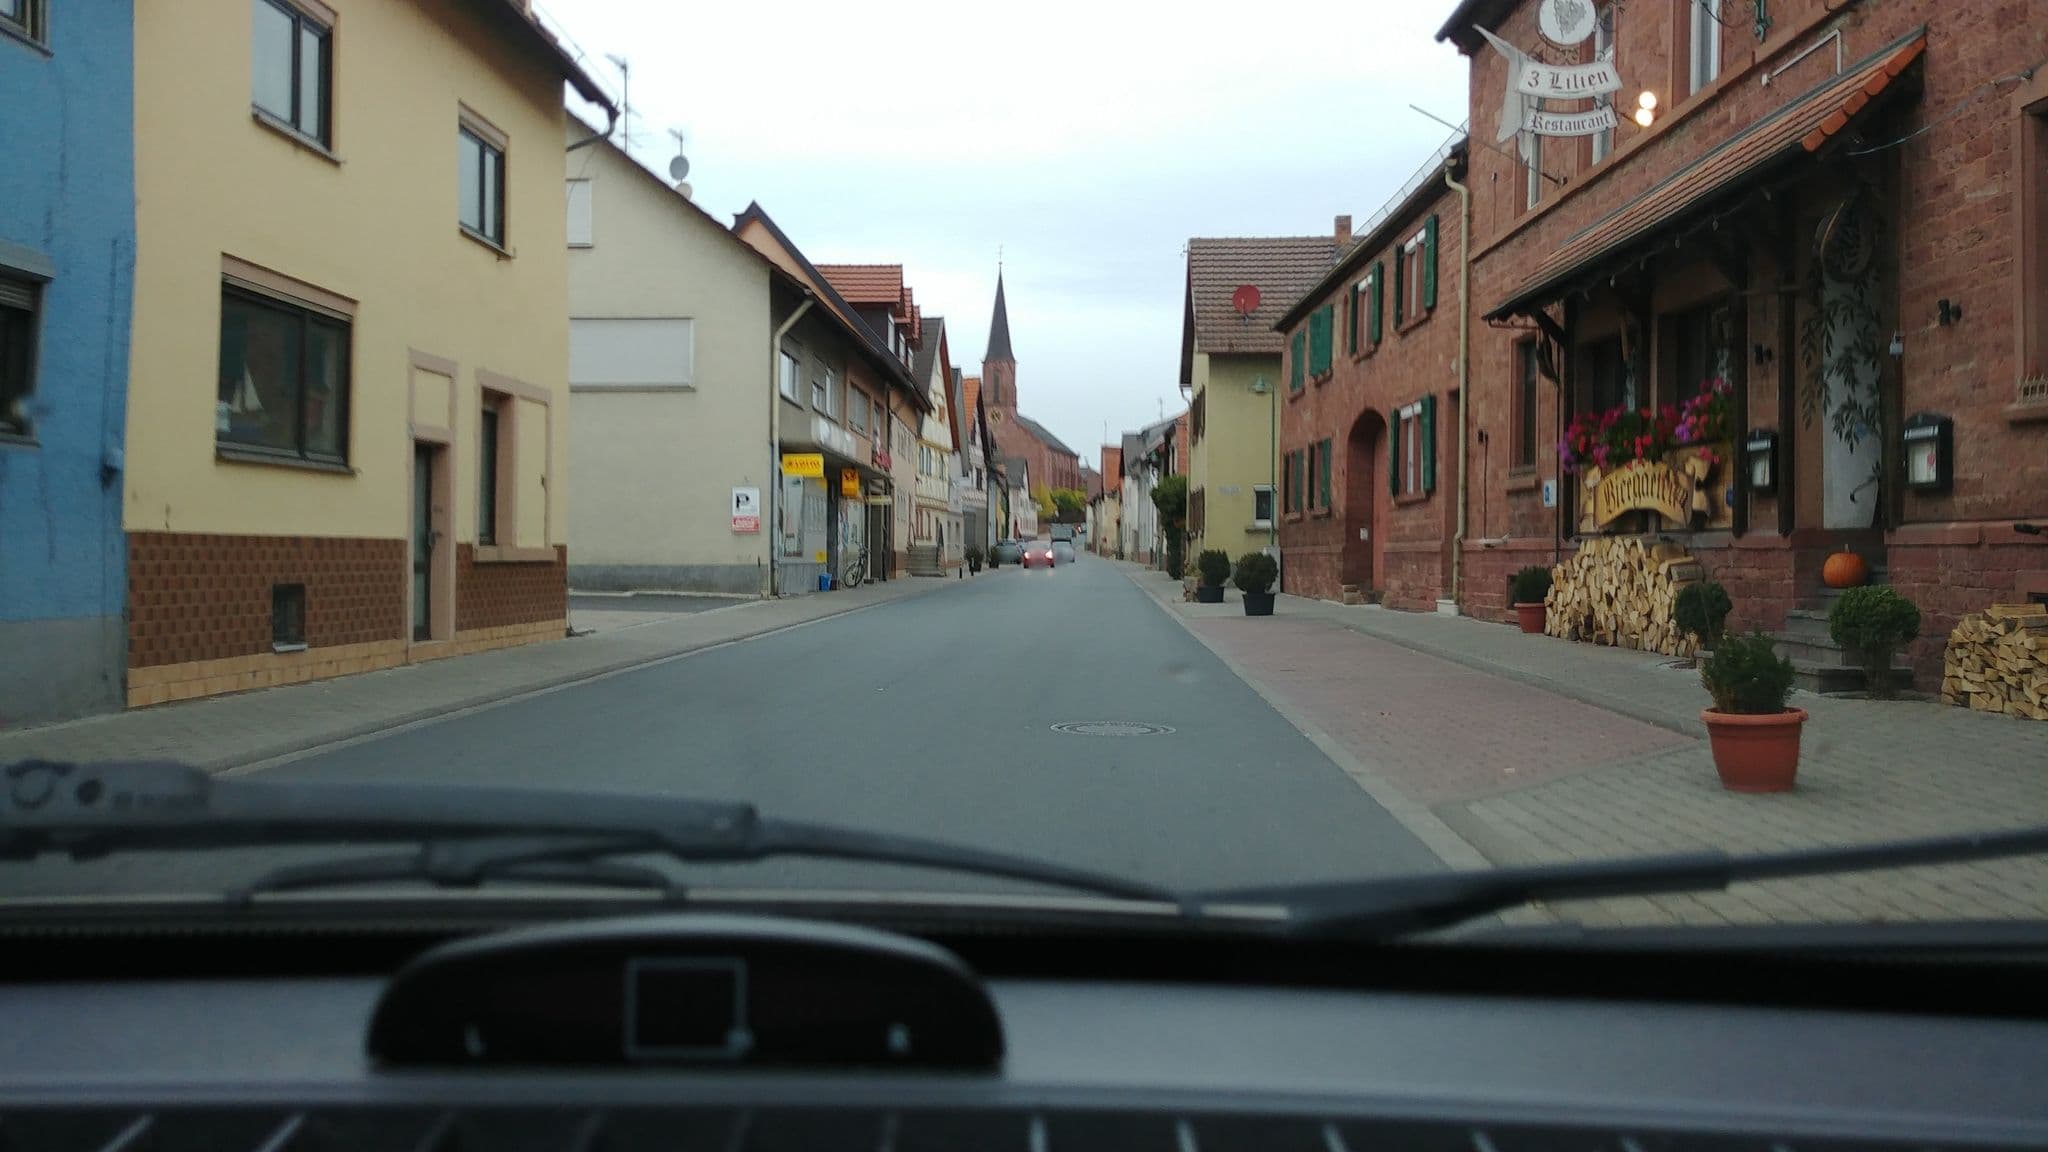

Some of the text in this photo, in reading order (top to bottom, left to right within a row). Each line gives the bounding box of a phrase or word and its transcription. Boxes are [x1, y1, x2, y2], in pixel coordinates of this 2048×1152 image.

[1527, 70, 1609, 90] 3 Lilien
[1531, 112, 1611, 132] Restaurant
